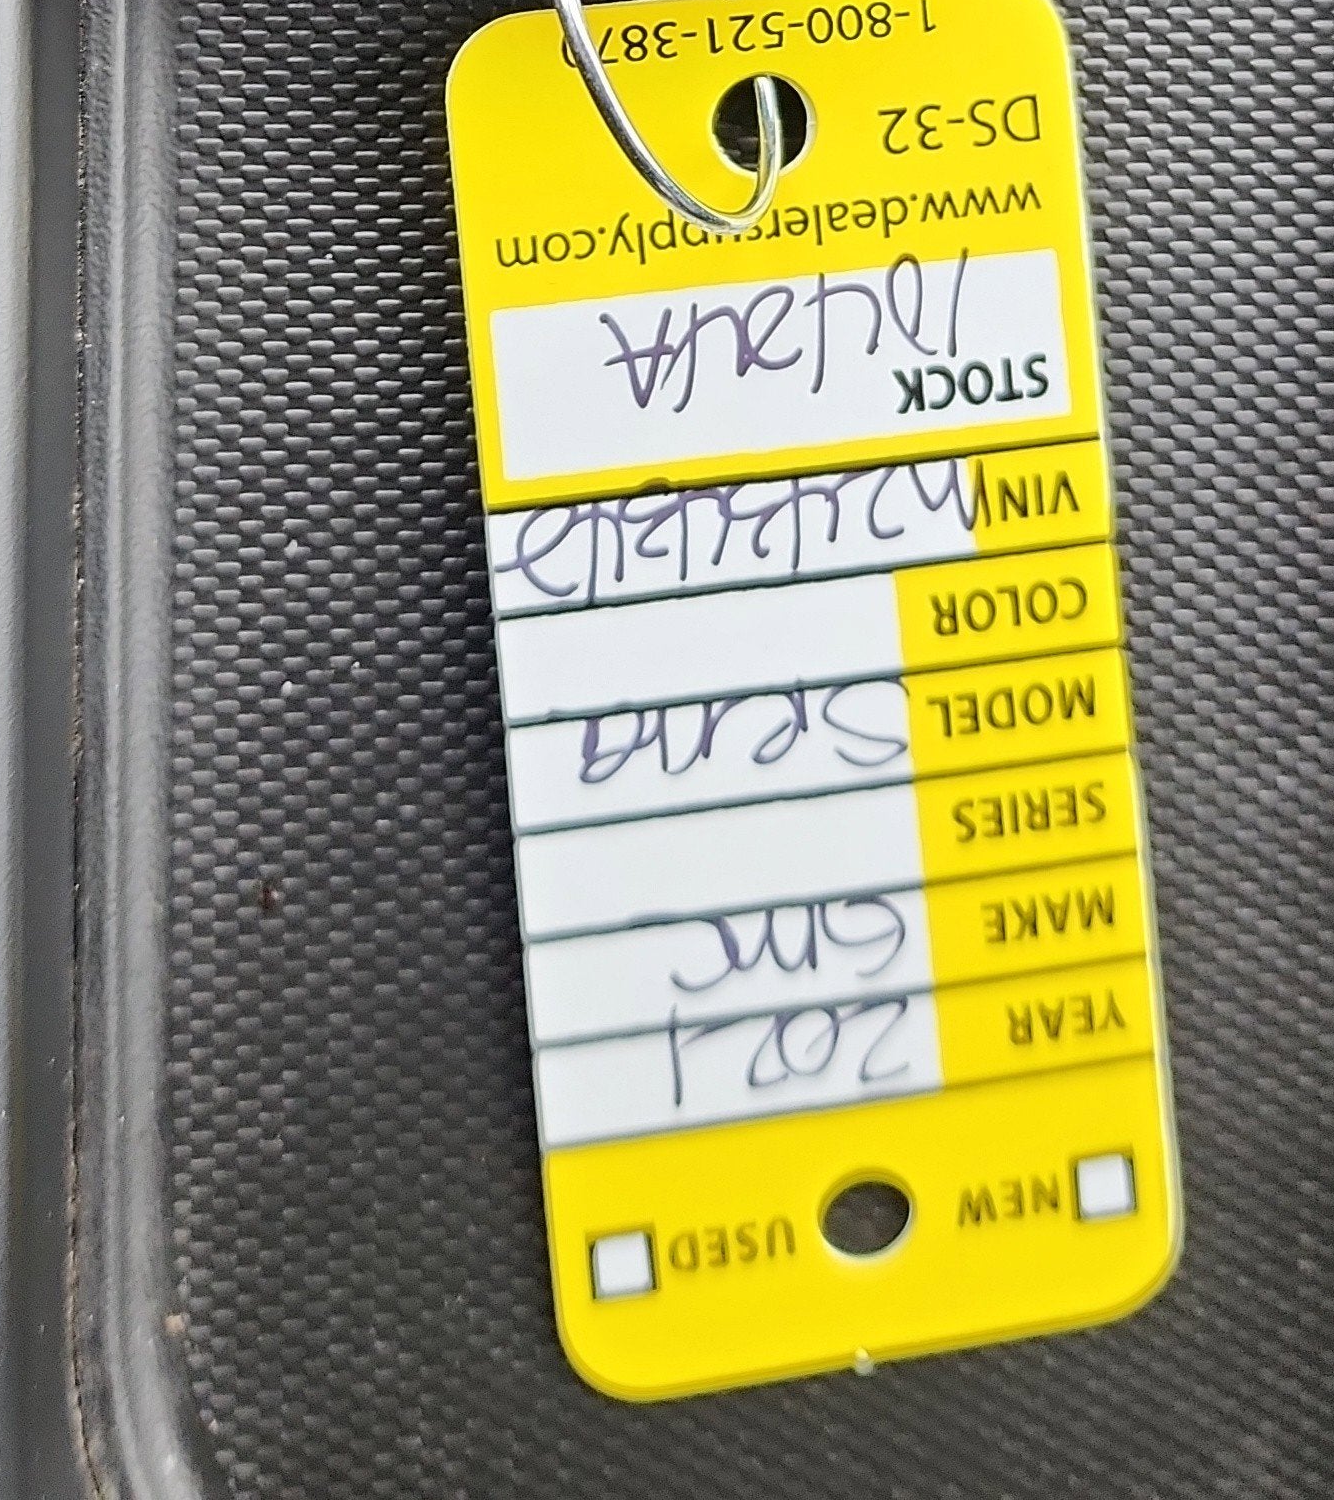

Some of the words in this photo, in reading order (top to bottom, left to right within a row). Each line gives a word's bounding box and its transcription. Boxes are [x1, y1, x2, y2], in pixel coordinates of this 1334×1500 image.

[878, 94, 1040, 153] DS-32
[495, 182, 1042, 268] www.dealerpply.com
[894, 353, 1049, 414] STOCK
[998, 469, 1080, 520] VIN
[930, 578, 1089, 636] COLOR
[927, 674, 1096, 738] MODEL
[952, 781, 1107, 843] SERIES
[982, 885, 1116, 945] MAKE
[1006, 988, 1127, 1047] YEAR
[666, 996, 910, 1108] 2021
[956, 1172, 1061, 1229] NEW
[667, 1215, 798, 1274] USED
